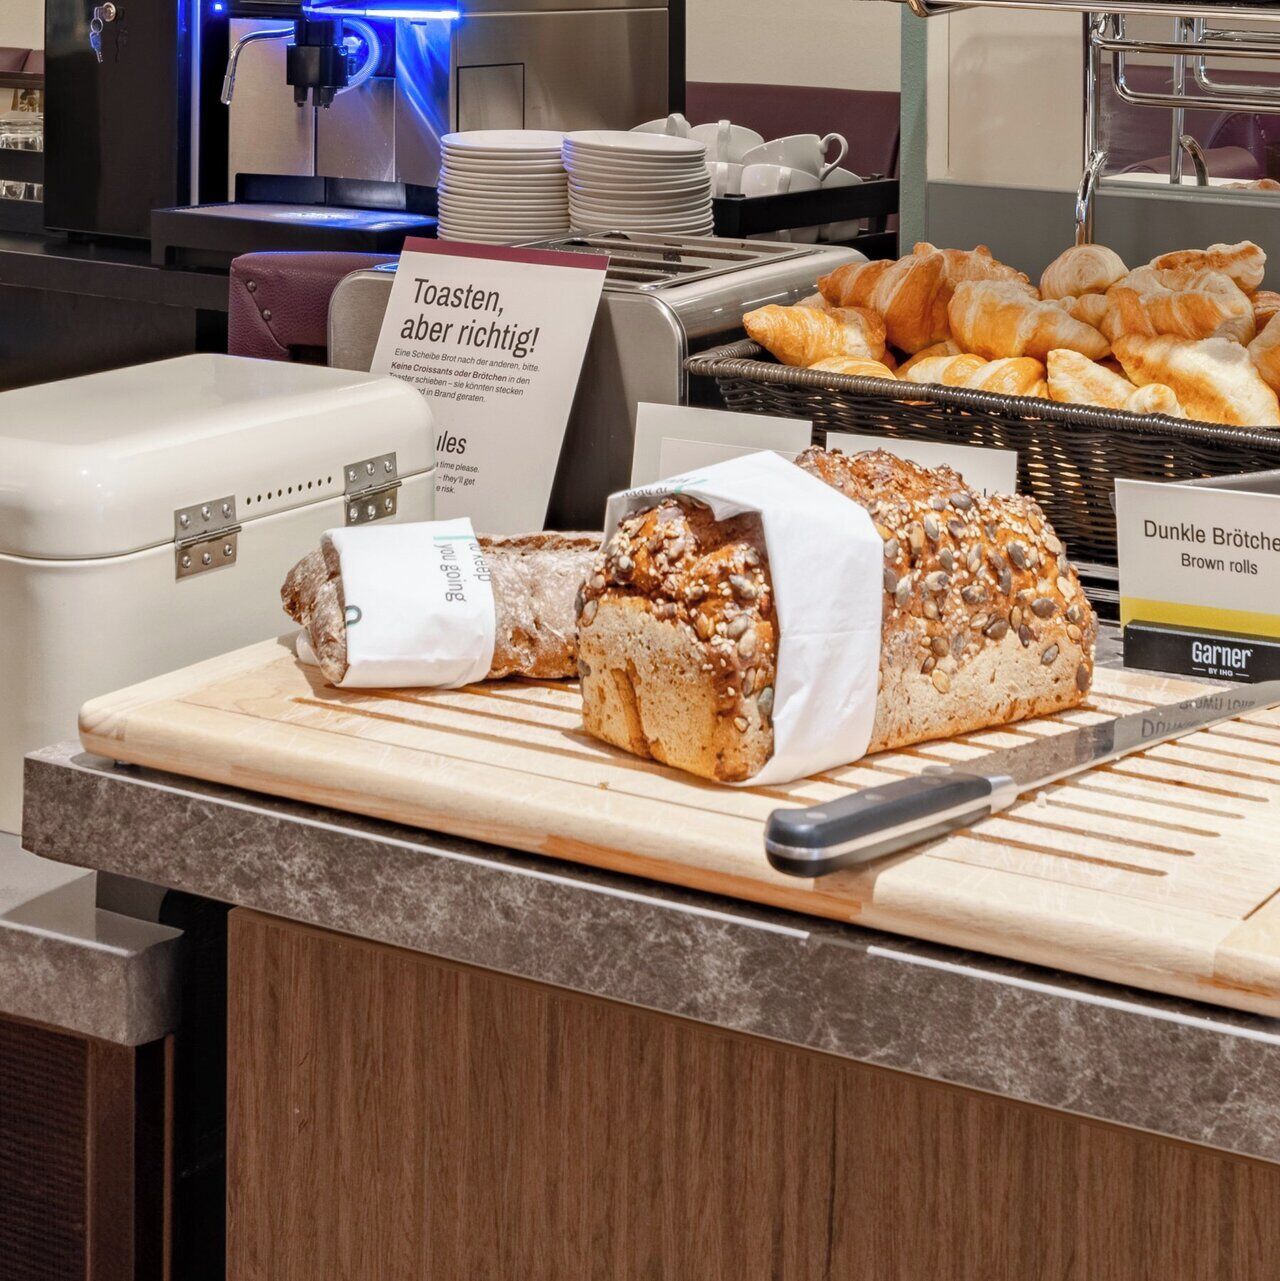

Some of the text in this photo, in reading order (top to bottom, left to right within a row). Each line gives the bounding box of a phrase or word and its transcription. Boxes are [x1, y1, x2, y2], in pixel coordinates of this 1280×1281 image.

[414, 278, 504, 317] Toasten,
[400, 313, 540, 358] aber richtig!
[395, 348, 411, 357] Eine
[411, 350, 440, 361] Scheibe
[441, 353, 457, 362] Brot
[457, 356, 475, 364] nach
[391, 361, 412, 371] Keine
[413, 364, 453, 376] Croissants
[454, 368, 471, 378] oder
[472, 371, 507, 382] Brötchen
[516, 376, 531, 385] den
[414, 376, 447, 386] schieben
[453, 381, 464, 389] sie
[495, 385, 524, 396] stecken
[434, 389, 456, 399] Brand
[456, 393, 486, 402] geraten.
[440, 461, 455, 470] time
[455, 464, 480, 473] please.
[441, 485, 455, 494] risk.
[463, 477, 475, 486] get
[1144, 519, 1206, 543] Dunkle
[433, 543, 467, 602] you going
[1181, 553, 1258, 575] Brown rolls
[1192, 641, 1252, 669] Garner
[1208, 667, 1234, 677] BY IHG
